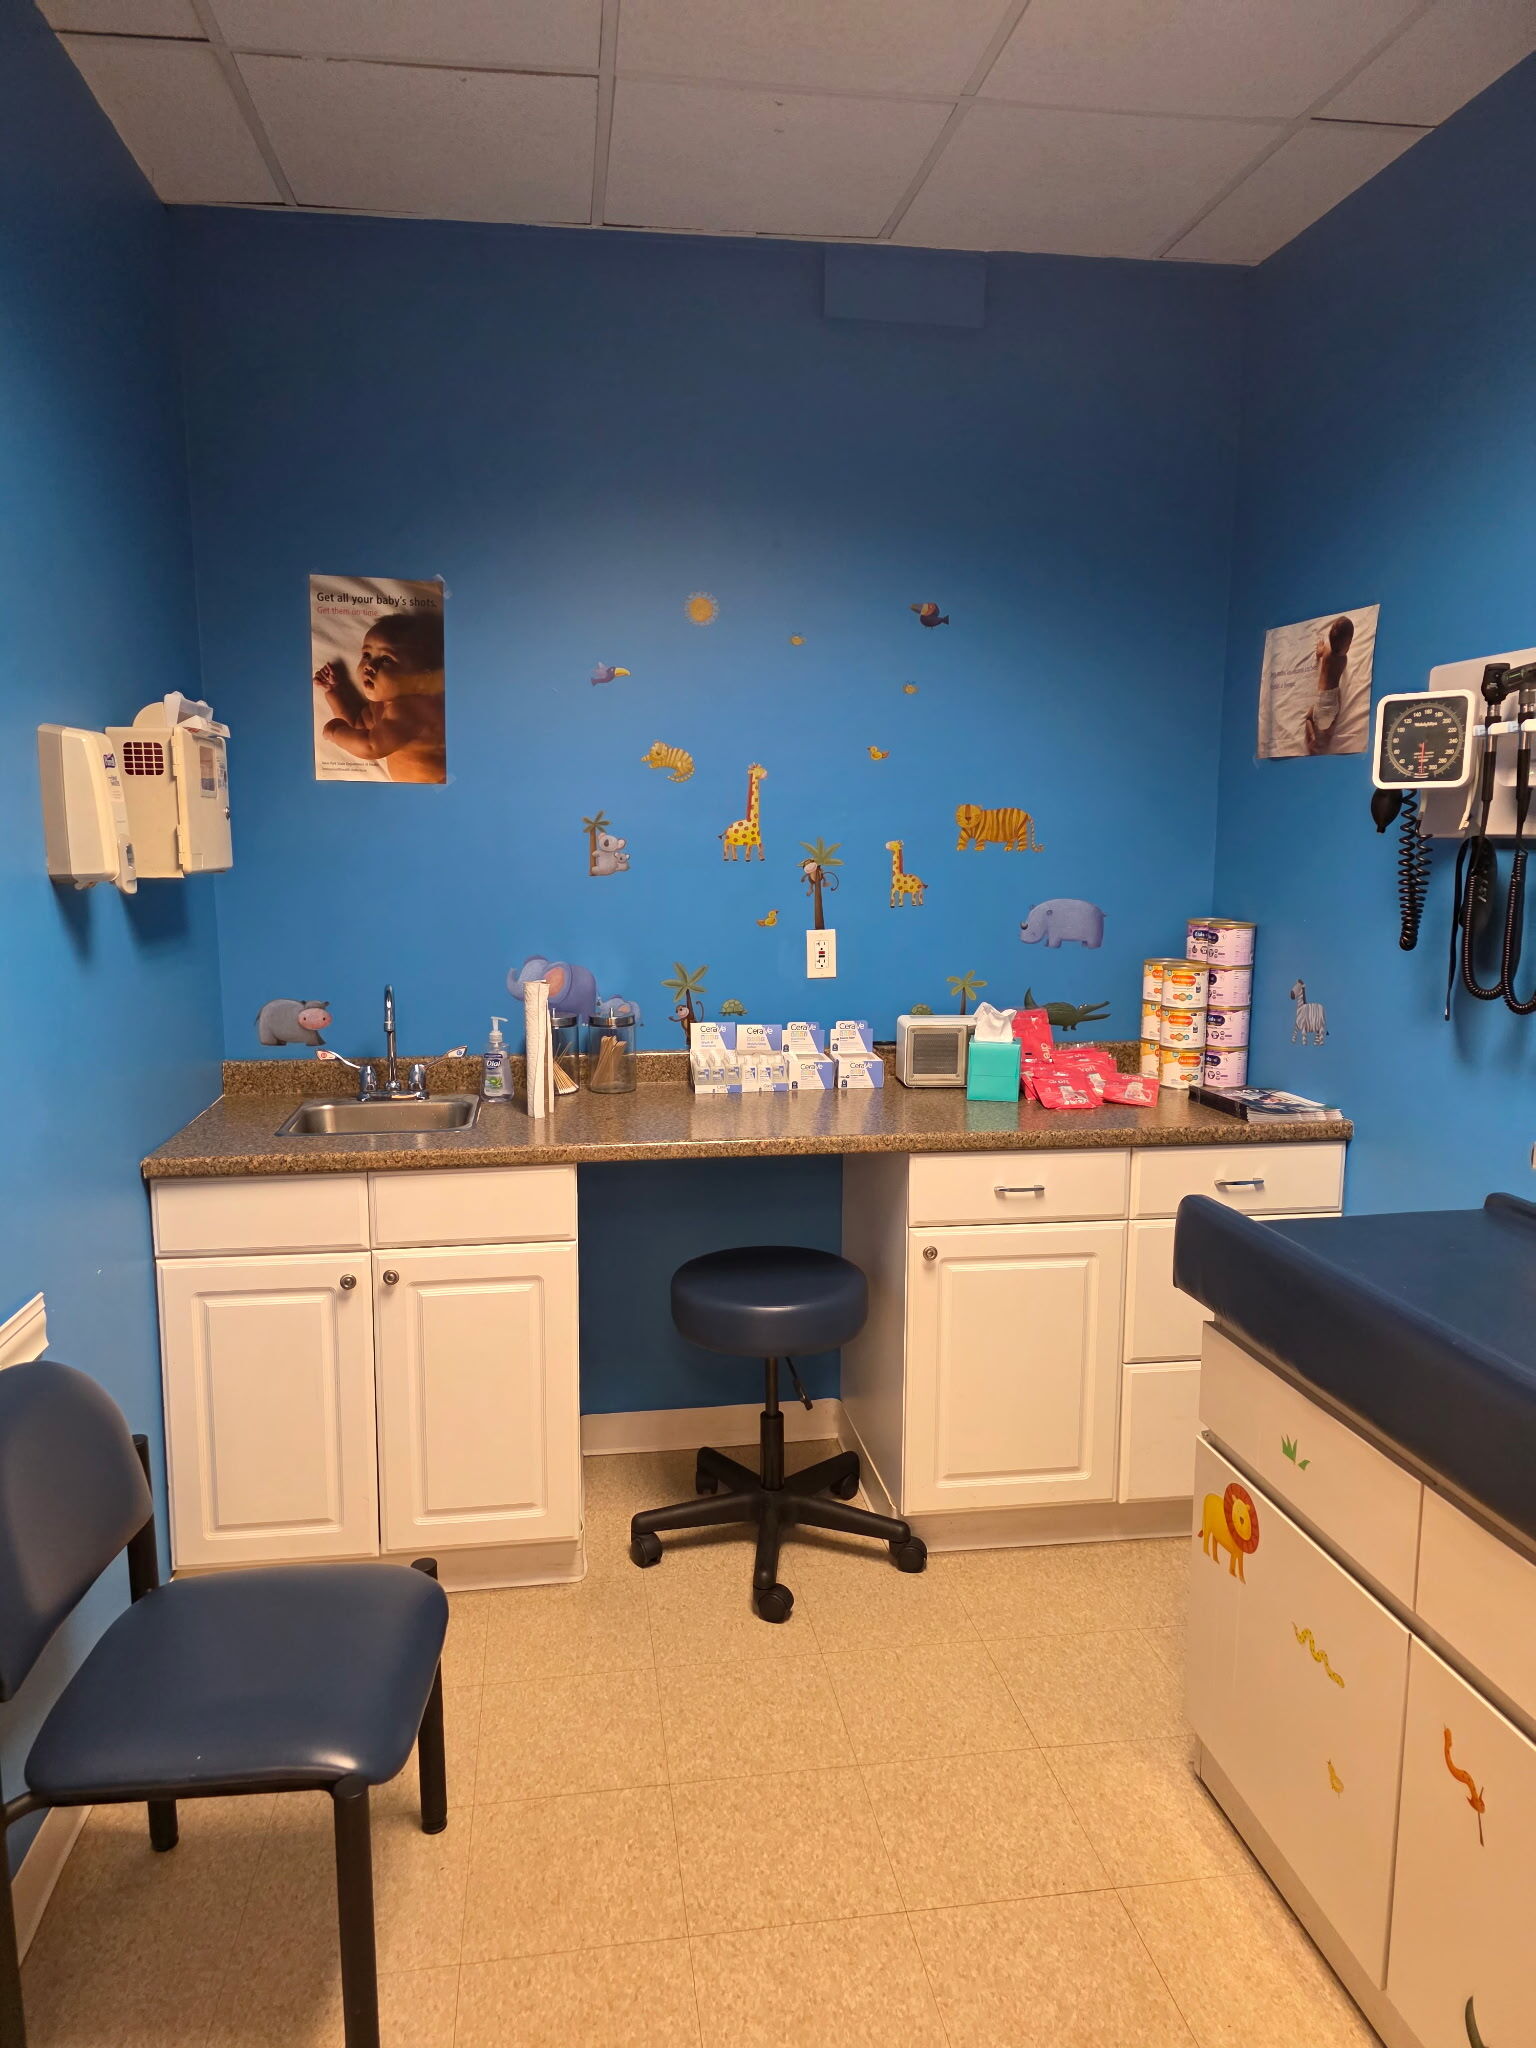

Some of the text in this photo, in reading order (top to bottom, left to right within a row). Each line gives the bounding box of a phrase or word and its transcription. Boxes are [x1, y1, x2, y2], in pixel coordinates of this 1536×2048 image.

[317, 592, 334, 602] Get
[337, 593, 349, 603] all
[351, 595, 373, 606] your
[376, 595, 407, 608] baby's
[317, 606, 330, 615] Get
[331, 607, 350, 616] them
[700, 1025, 727, 1033] CeraVe
[790, 1023, 817, 1031] CeraVe
[839, 1022, 865, 1030] CeraVe
[746, 1026, 773, 1035] CeraVe
